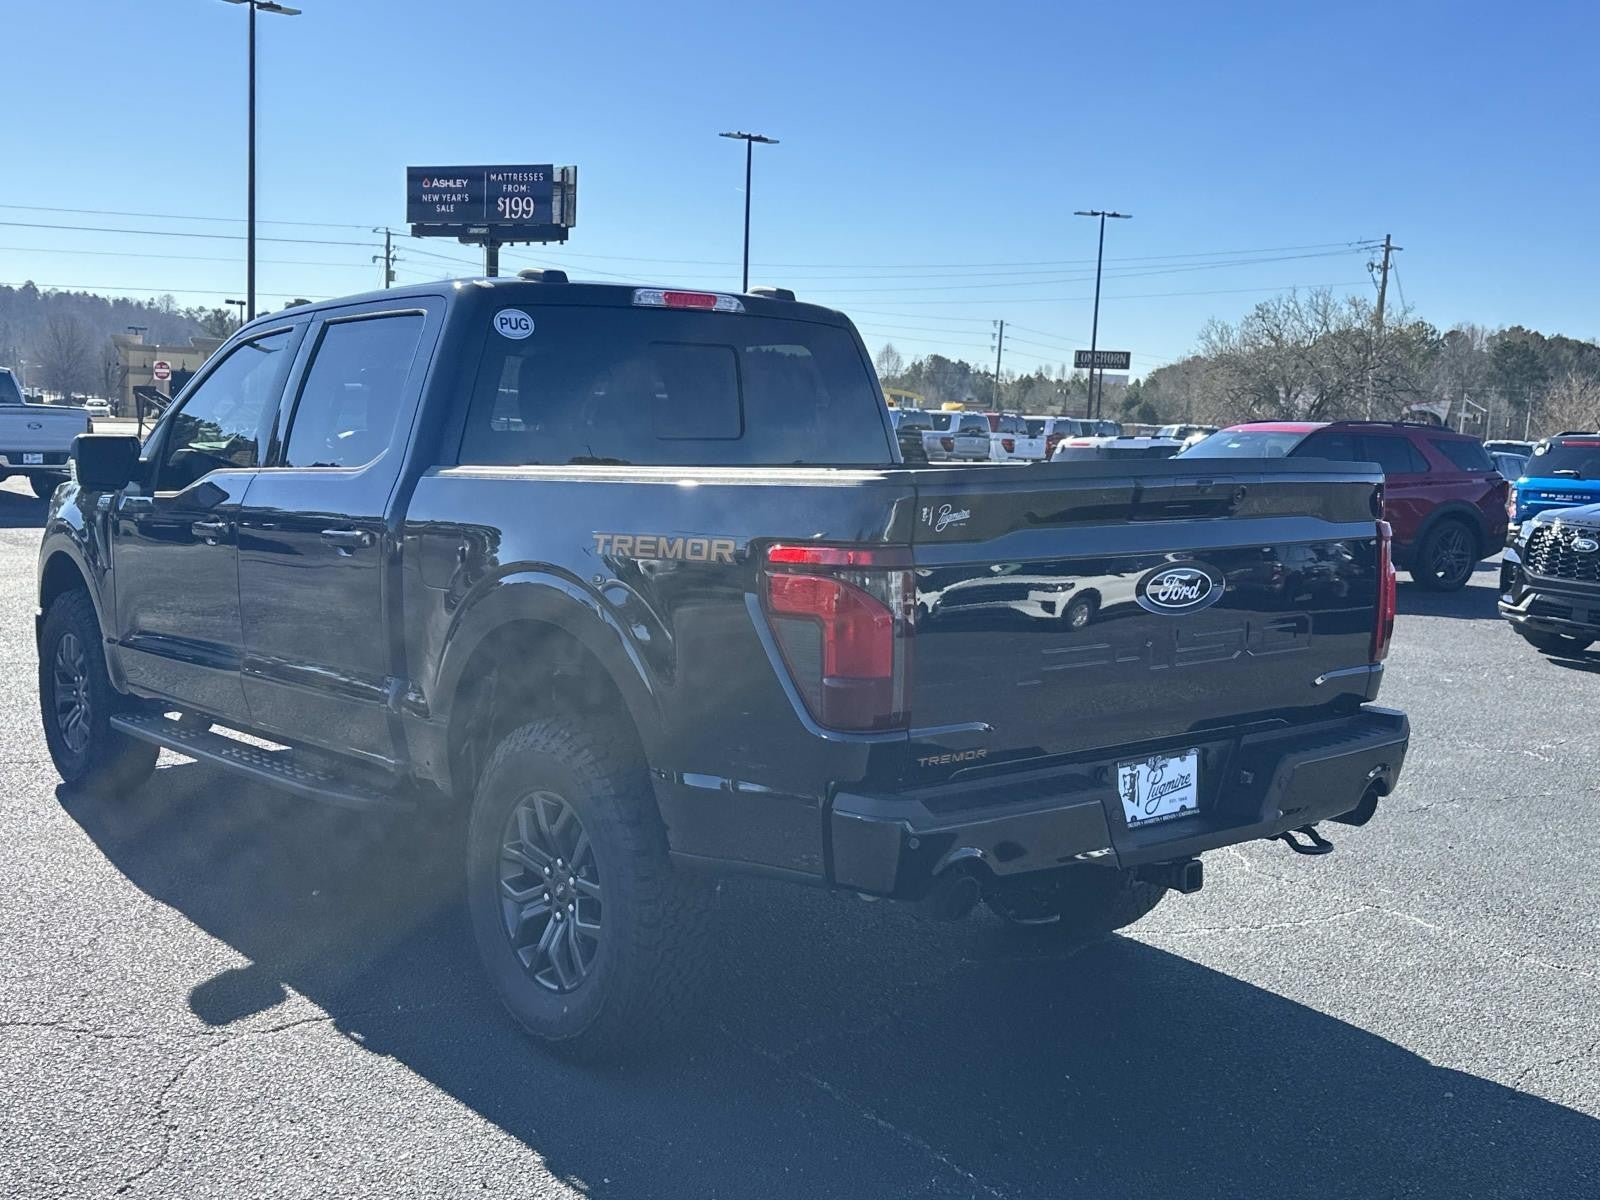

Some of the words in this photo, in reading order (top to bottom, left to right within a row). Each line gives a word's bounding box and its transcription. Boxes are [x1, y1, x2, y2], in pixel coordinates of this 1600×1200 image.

[432, 179, 468, 188] ASHLEY
[490, 173, 545, 182] MATTRESSES
[502, 184, 530, 193] FROM:
[422, 194, 439, 202] NEW
[442, 194, 470, 202] YEAR'S
[436, 204, 454, 213] SALE
[497, 196, 535, 219] $199
[499, 317, 530, 331] PUG
[592, 532, 736, 564] TREMOR
[1158, 574, 1202, 602] Ford
[917, 748, 987, 768] TREMOR
[1144, 764, 1192, 815] Pugmire
